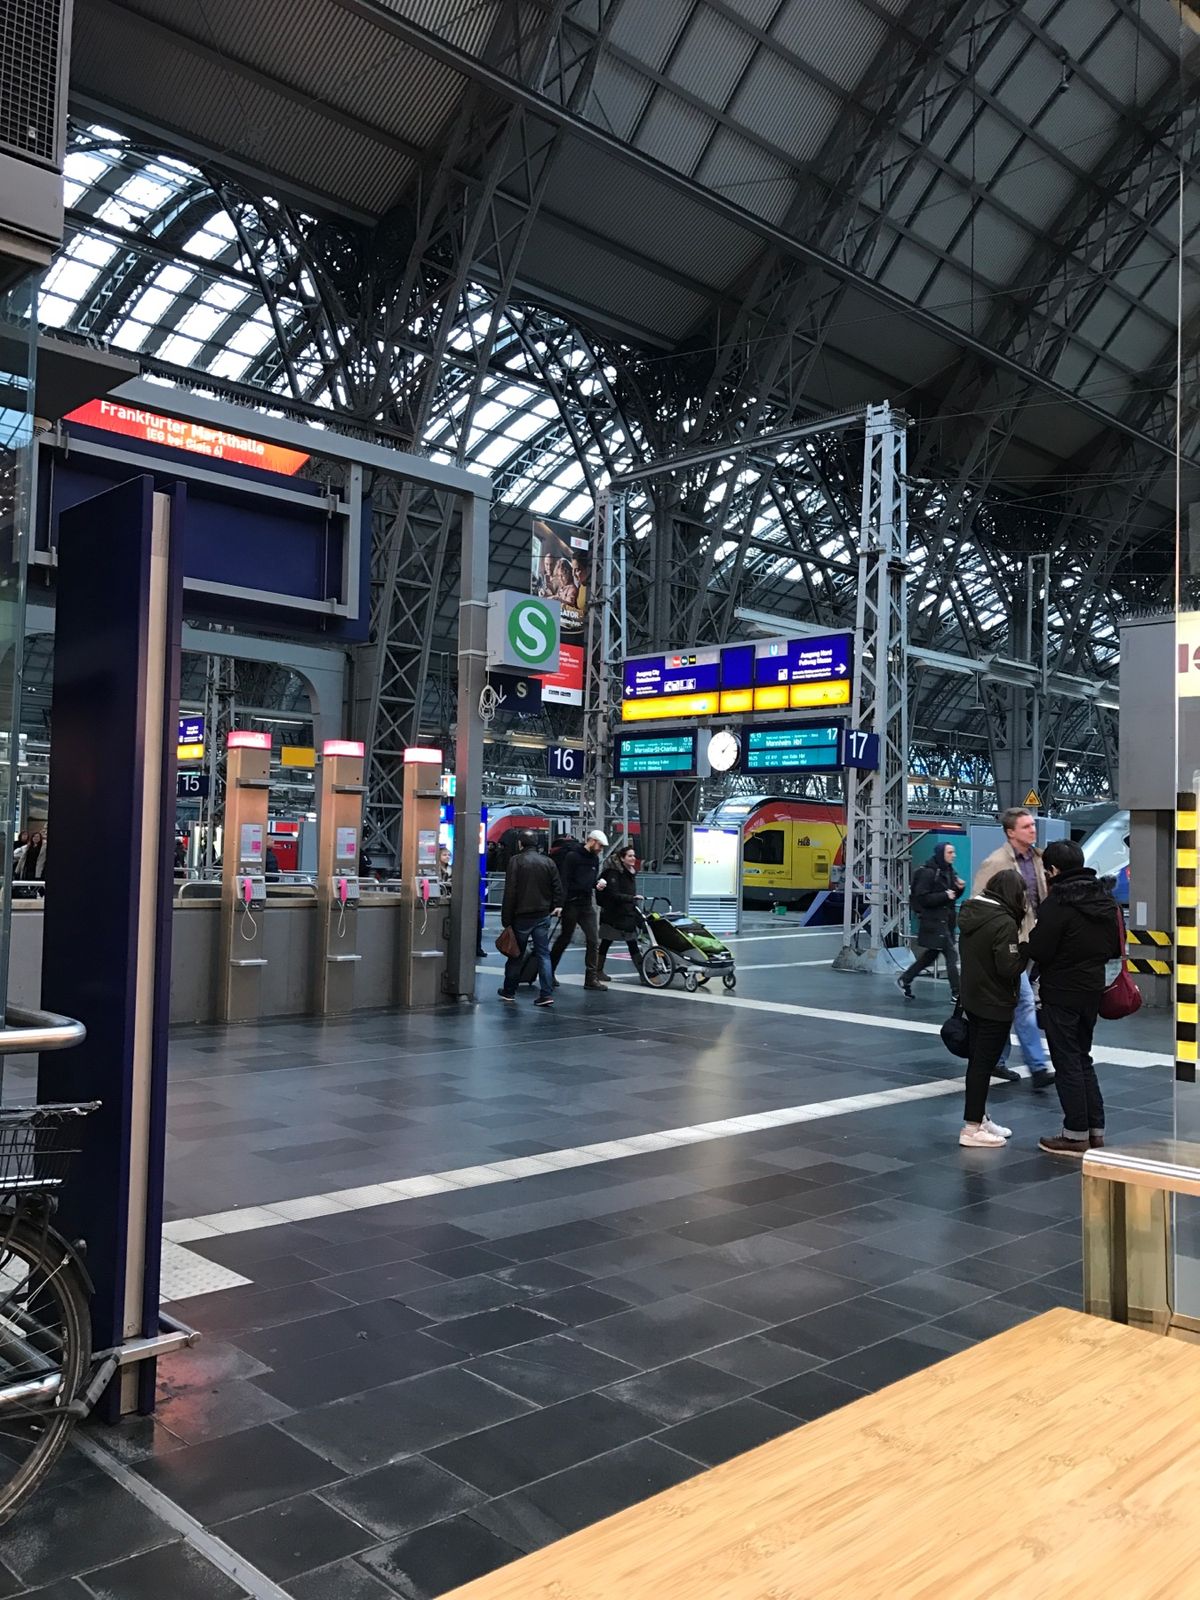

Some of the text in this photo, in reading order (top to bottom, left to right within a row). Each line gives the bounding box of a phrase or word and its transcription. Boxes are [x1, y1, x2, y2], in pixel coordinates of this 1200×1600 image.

[101, 400, 265, 456] Frankfurter Markthalle
[146, 427, 165, 443] (EG
[167, 432, 184, 447] bei
[186, 439, 212, 455] Gleis
[515, 606, 547, 657] S
[770, 644, 778, 656] U
[516, 681, 528, 698] S
[826, 727, 838, 740] 17
[621, 740, 631, 752] 16
[765, 739, 792, 747] Mannheim
[849, 731, 869, 760] 17
[553, 748, 574, 771] 16
[182, 775, 200, 792] 15
